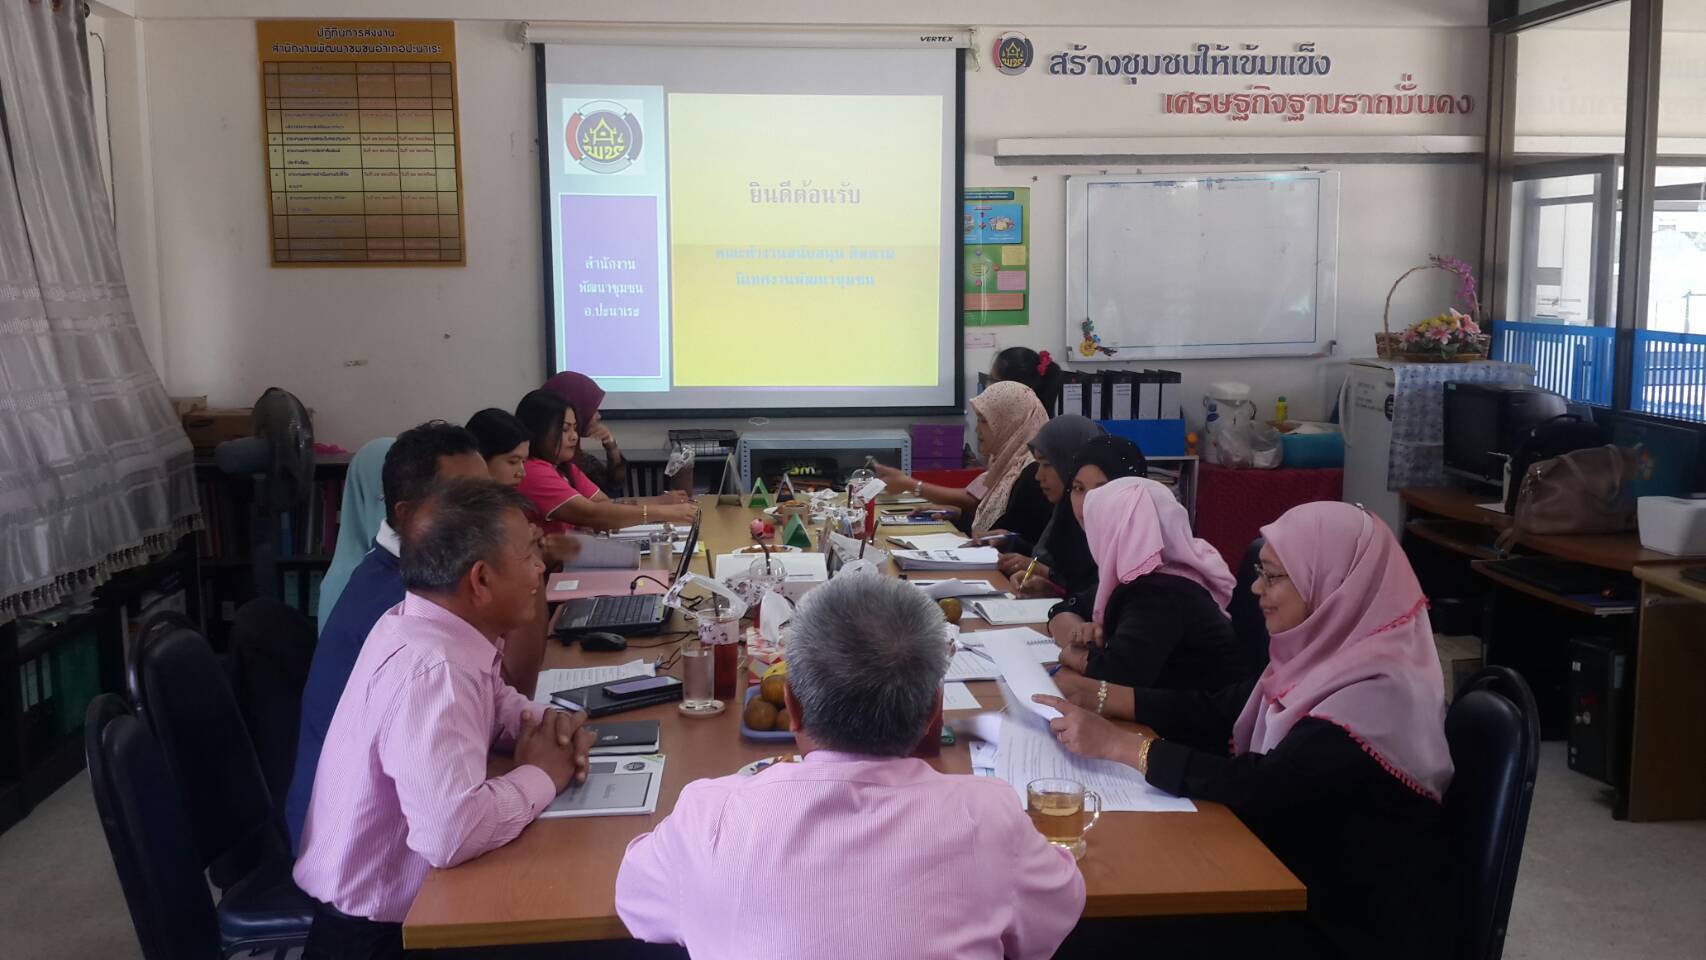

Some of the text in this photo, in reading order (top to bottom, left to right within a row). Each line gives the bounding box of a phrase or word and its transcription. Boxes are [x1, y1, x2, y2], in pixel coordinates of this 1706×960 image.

[1049, 43, 1331, 85] สร้างชุมชนให้เข้มแข็ง
[1163, 73, 1474, 121] เศรษฐกิจฐานรากมั่นคง
[749, 179, 861, 205] ยินดีต้อนรับ
[585, 256, 636, 271] สำนักงาน
[578, 281, 644, 298] พัฒนาชุมชน
[584, 302, 640, 318] อ.ปะนาเระ
